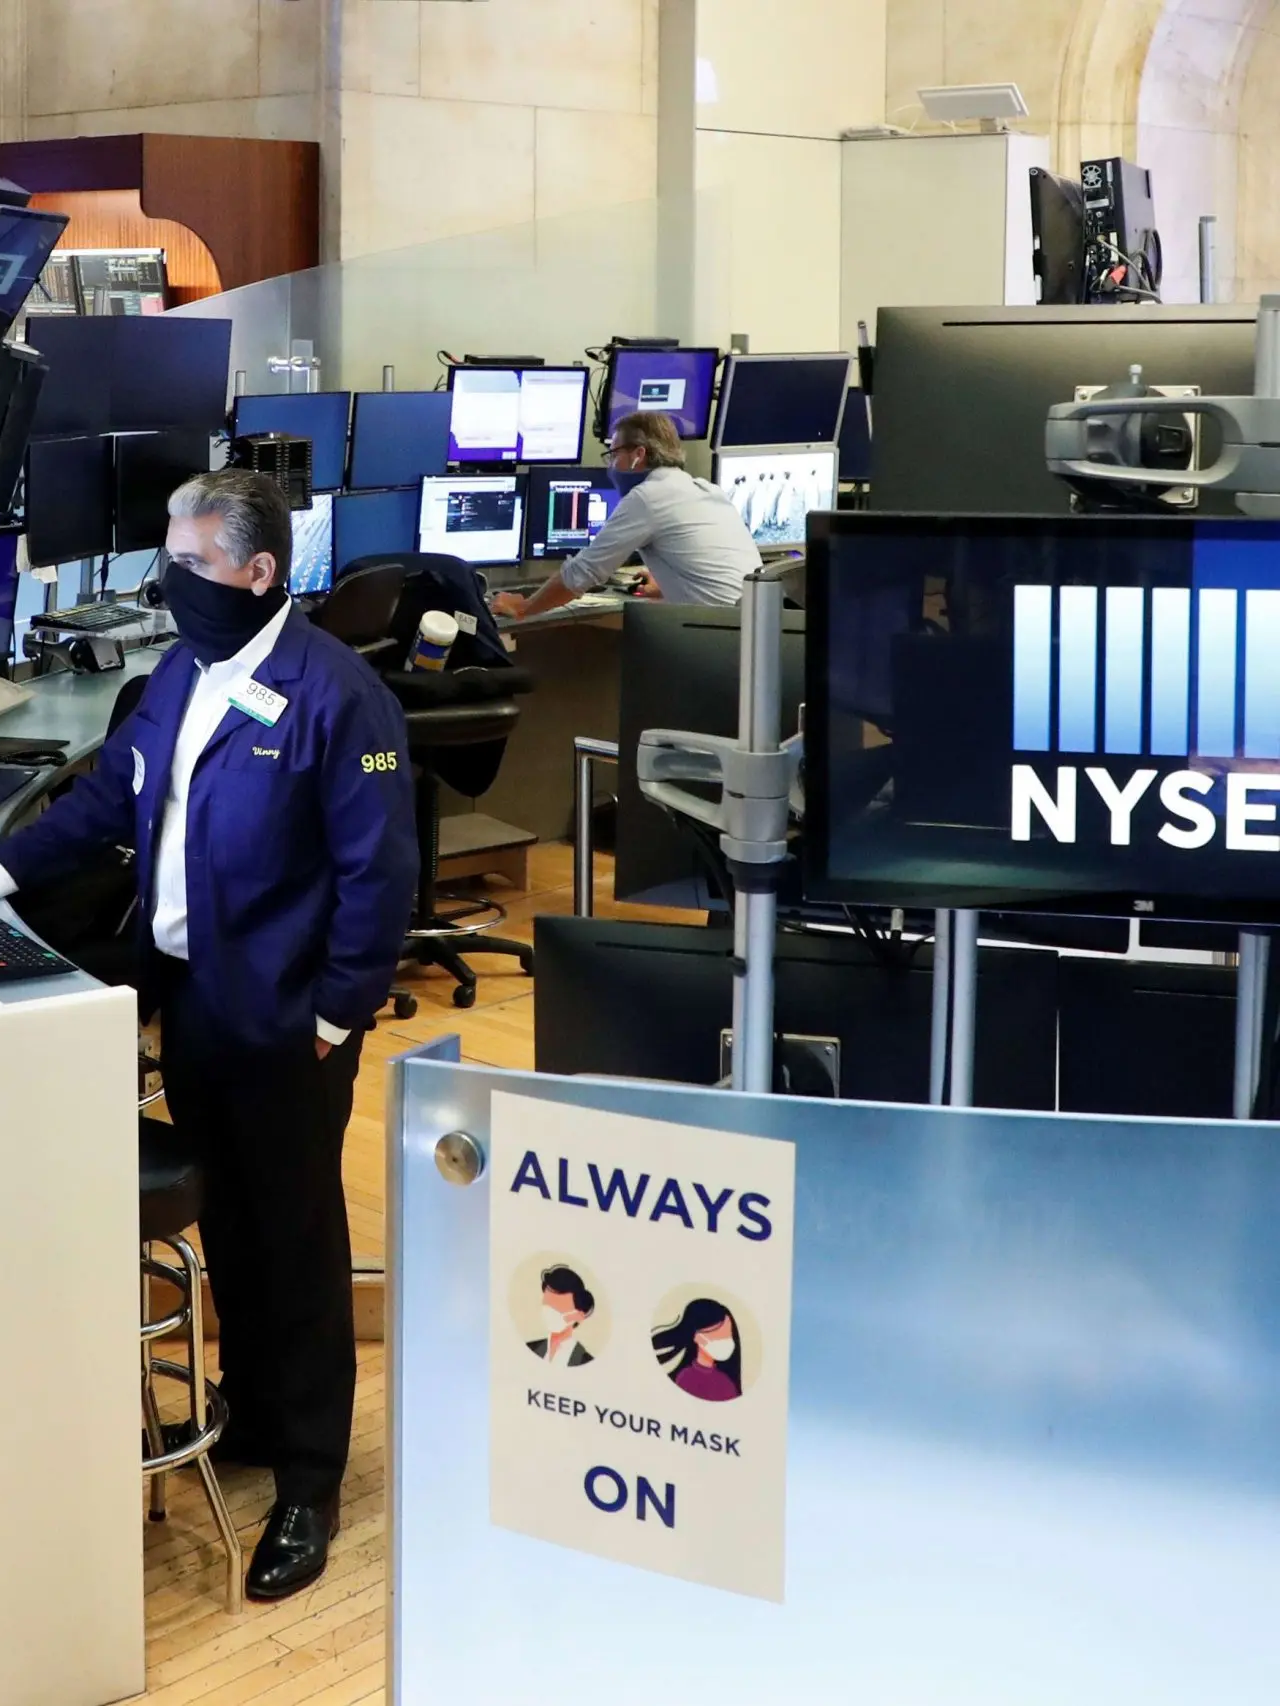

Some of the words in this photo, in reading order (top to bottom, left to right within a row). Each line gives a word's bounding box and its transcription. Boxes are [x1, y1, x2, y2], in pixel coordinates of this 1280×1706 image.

[247, 682, 275, 706] 985
[252, 746, 280, 759] Vinny
[361, 752, 397, 773] 985
[1011, 765, 1280, 852] NYSE
[510, 1150, 773, 1241] ALWAYS
[527, 1389, 587, 1417] KEEP
[595, 1405, 661, 1437] YOUR
[670, 1424, 741, 1457] MASK
[584, 1465, 675, 1529] ON
